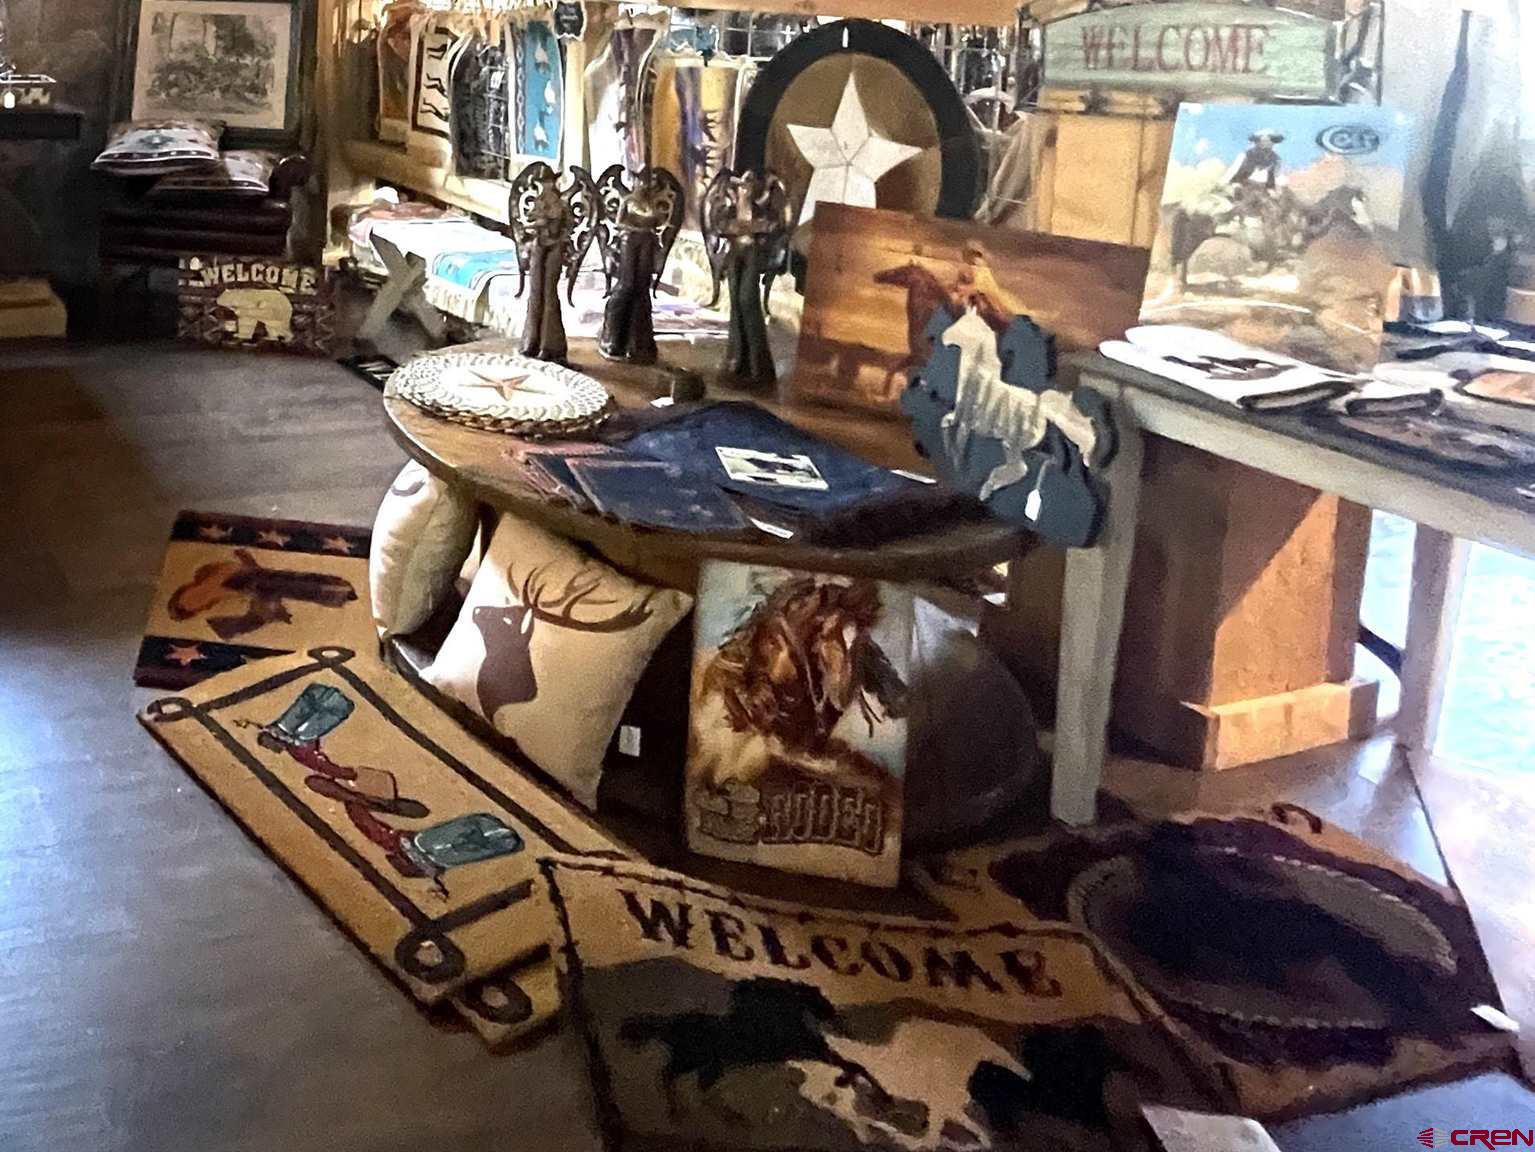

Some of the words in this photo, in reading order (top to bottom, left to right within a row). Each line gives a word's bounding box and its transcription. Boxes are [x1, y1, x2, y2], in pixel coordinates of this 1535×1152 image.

[1080, 22, 1271, 74] WELCOME
[200, 262, 317, 296] WELCOME
[617, 887, 1064, 998] WELCOME
